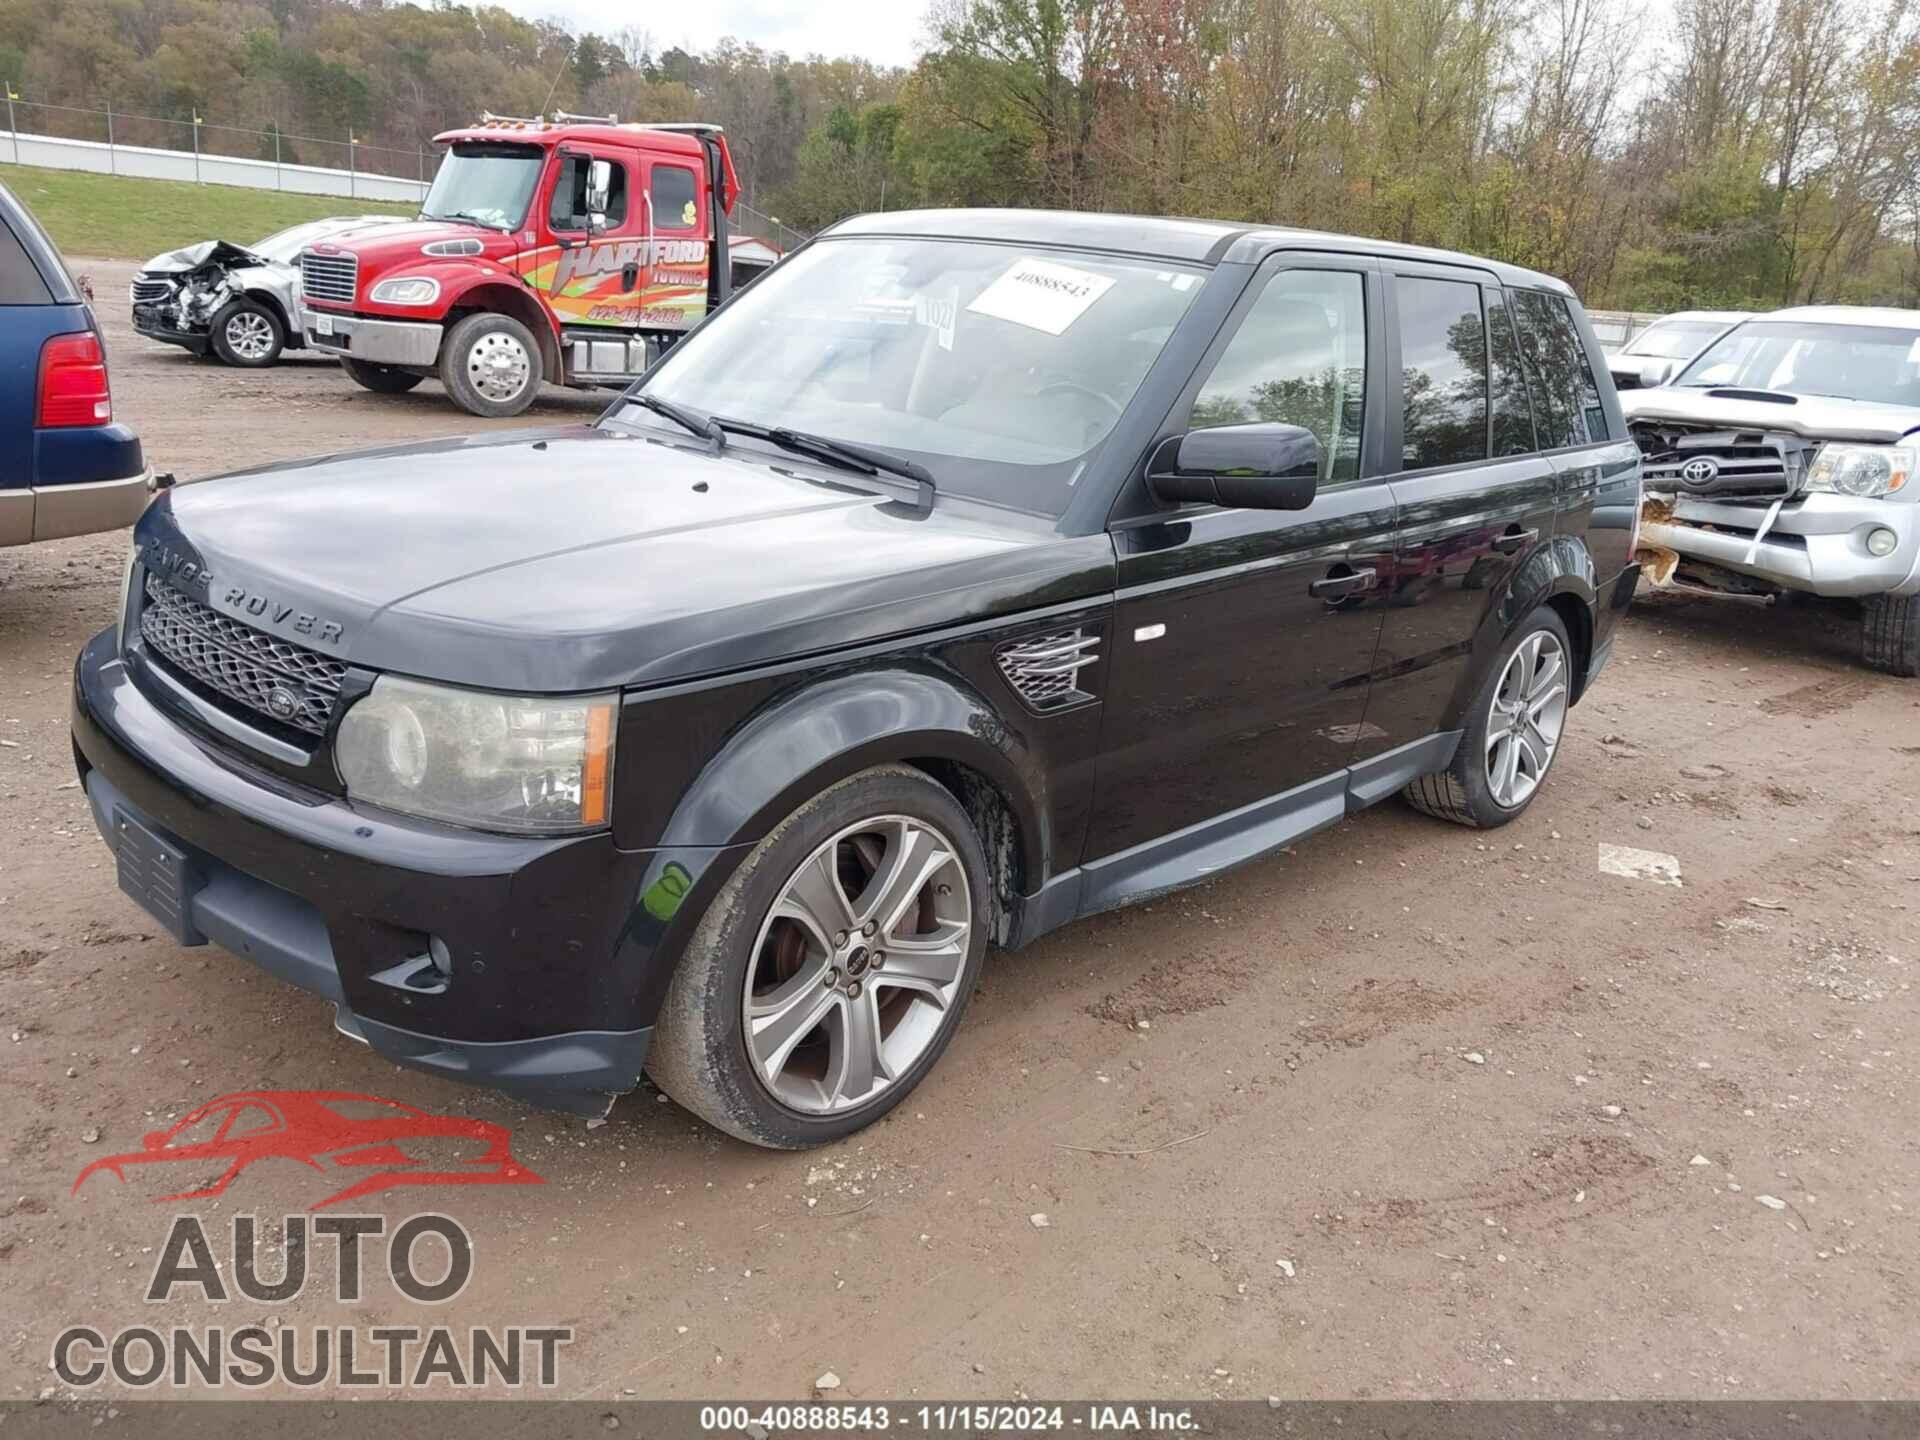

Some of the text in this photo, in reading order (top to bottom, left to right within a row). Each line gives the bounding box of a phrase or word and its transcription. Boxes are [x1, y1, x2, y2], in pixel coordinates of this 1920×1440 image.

[551, 241, 705, 299] HARTFORD
[653, 271, 704, 285] TOWING
[1014, 270, 1091, 298] 40888543
[224, 585, 344, 644] ROVER
